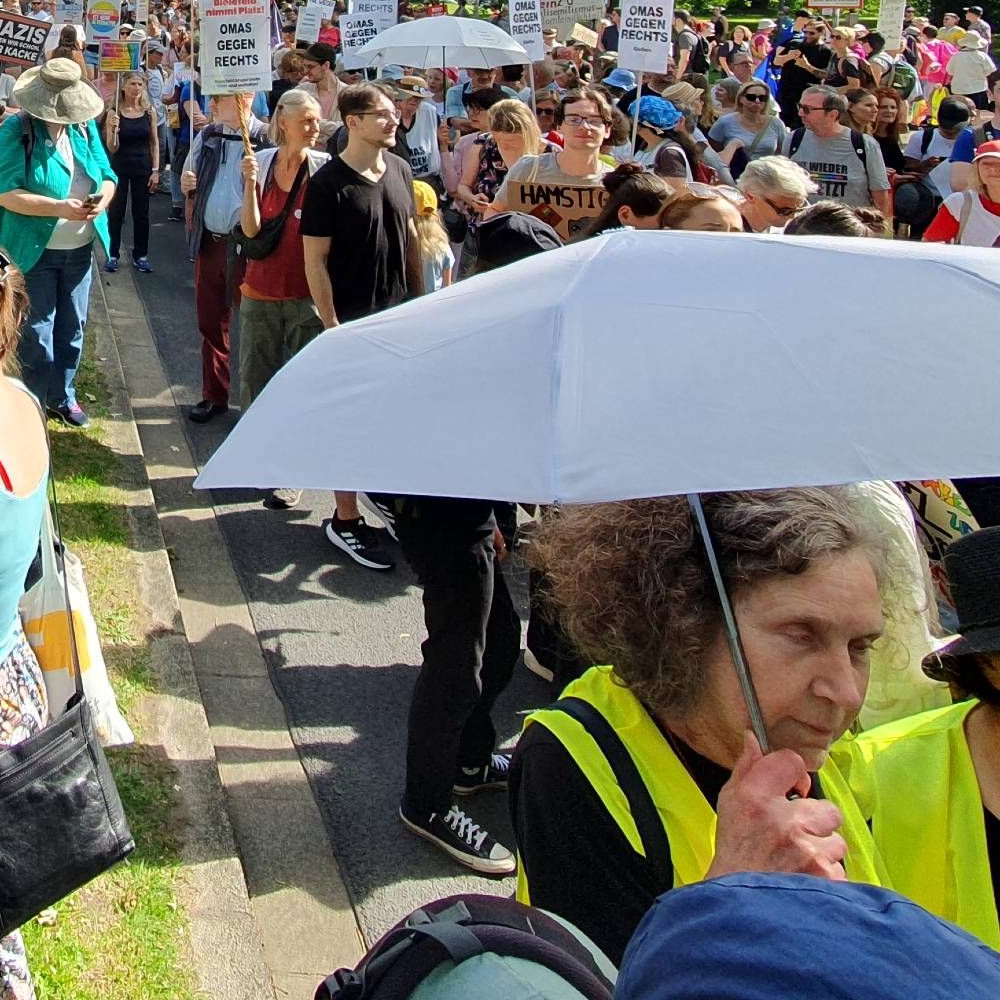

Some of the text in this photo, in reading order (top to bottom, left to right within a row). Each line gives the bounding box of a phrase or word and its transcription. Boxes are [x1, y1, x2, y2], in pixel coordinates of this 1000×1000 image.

[205, 5, 265, 17] nimmt Platz!
[358, 4, 393, 13] RECHTS
[514, 0, 536, 12] OMAS
[629, 5, 664, 17] OMAS
[513, 12, 538, 23] GEGEN
[625, 17, 666, 30] GEGEN
[219, 22, 252, 35] OMAS
[346, 19, 374, 30] OMAS
[512, 24, 541, 35] RECHTS
[344, 28, 378, 38] GEGEN
[621, 29, 668, 42] RECHTS
[217, 38, 256, 51] GEGEN
[4, 47, 38, 61] KACKE
[214, 54, 259, 67] RECHTS
[809, 162, 848, 174] WIEDER
